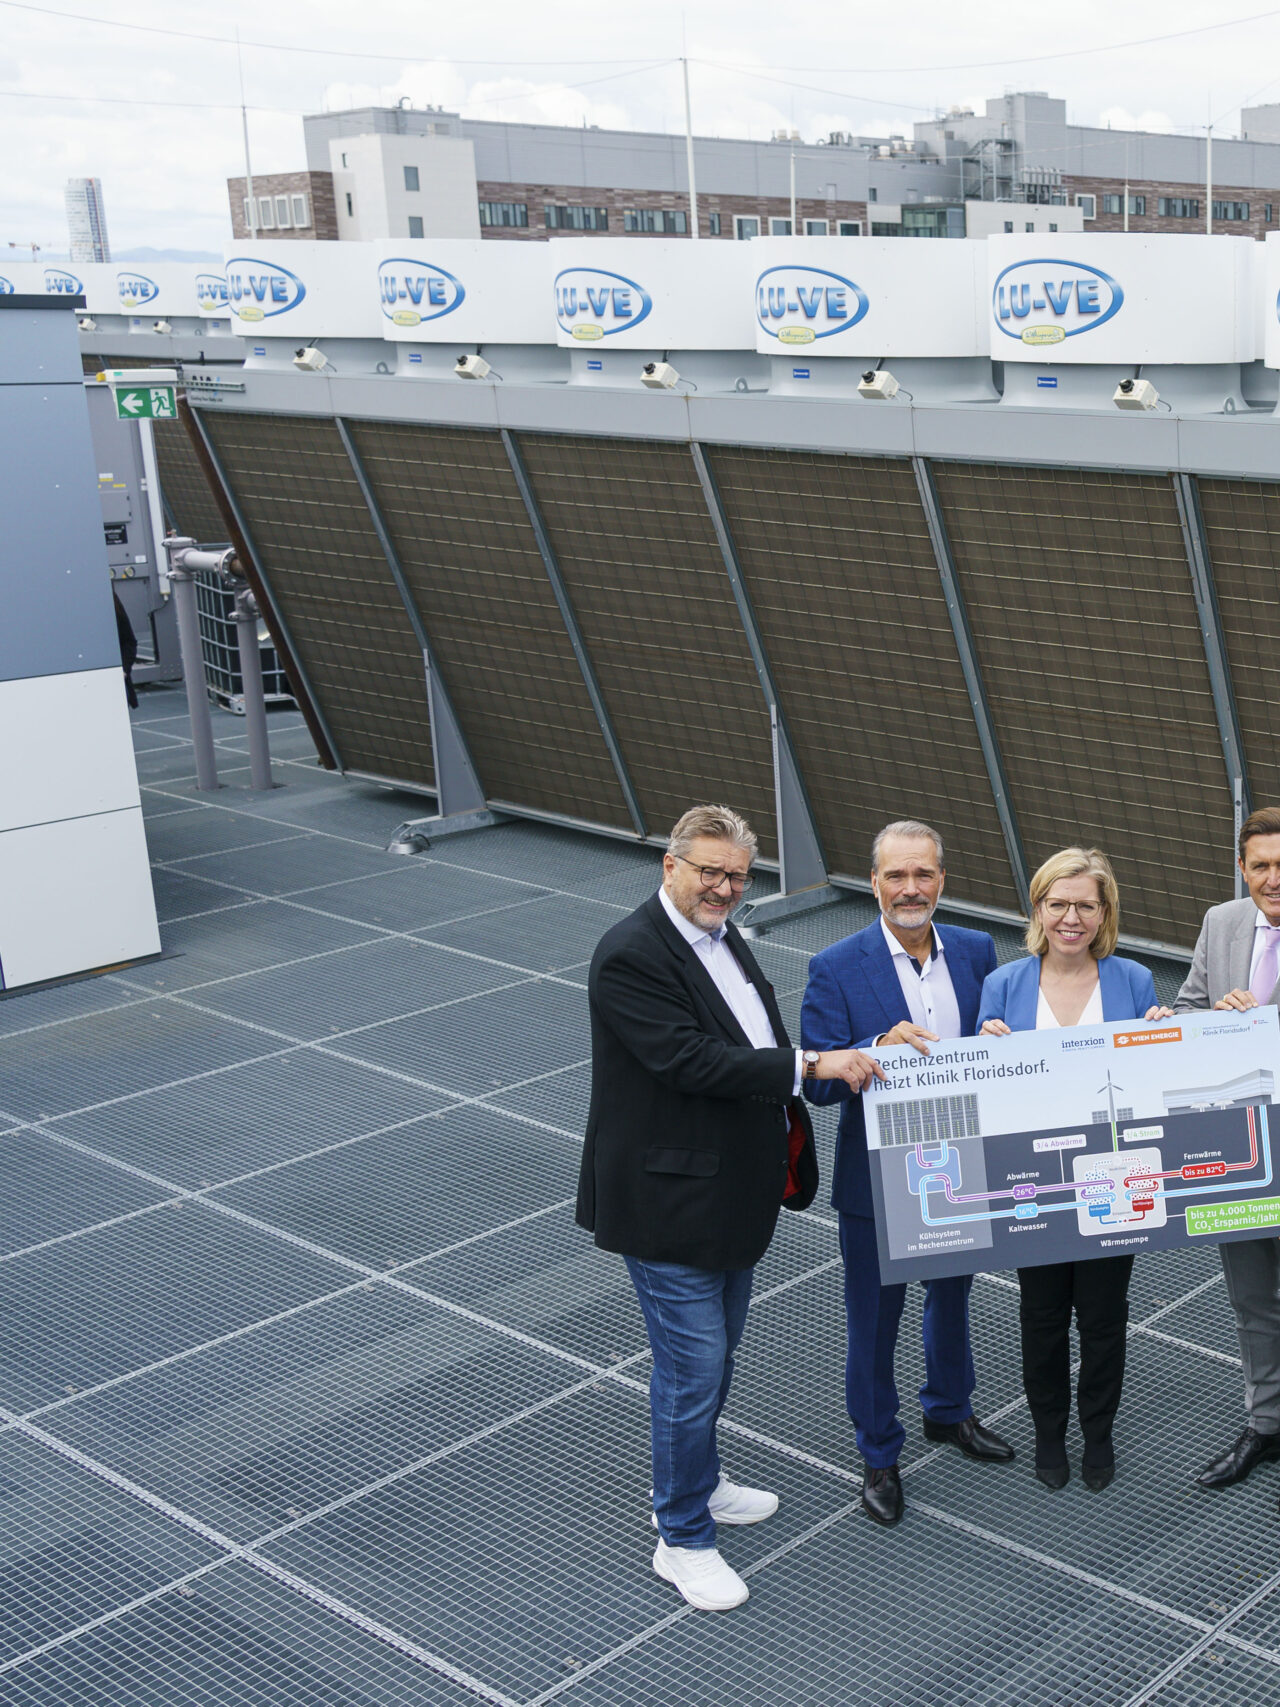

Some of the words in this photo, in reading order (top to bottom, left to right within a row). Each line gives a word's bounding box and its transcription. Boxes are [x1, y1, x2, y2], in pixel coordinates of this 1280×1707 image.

[759, 287, 848, 319] LU-VE
[999, 279, 1101, 320] LU-VE
[1151, 1031, 1179, 1040] ENERGIE
[1061, 1037, 1105, 1049] interxion
[875, 1049, 989, 1071] echenzentrum
[874, 1075, 912, 1092] heizt
[916, 1070, 960, 1087] Klinik
[964, 1059, 1050, 1082] Floridsdorf.
[1036, 1141, 1049, 1149] 3/4
[1050, 1137, 1083, 1148] Abwärme
[1183, 1150, 1222, 1160] Fernwärme
[1006, 1170, 1040, 1181] Abwärme
[1184, 1168, 1195, 1177] bis
[1191, 1210, 1205, 1220] bis
[1206, 1210, 1217, 1218] zu
[1219, 1205, 1246, 1217] 4.000
[1248, 1202, 1280, 1213] Tonnen
[1008, 1222, 1048, 1233] Kaltwasser
[919, 1229, 961, 1241] Kühlsystem
[907, 1243, 917, 1251] im
[918, 1237, 974, 1250] Rechenzentrum
[1100, 1236, 1149, 1248] Wärmepumpe
